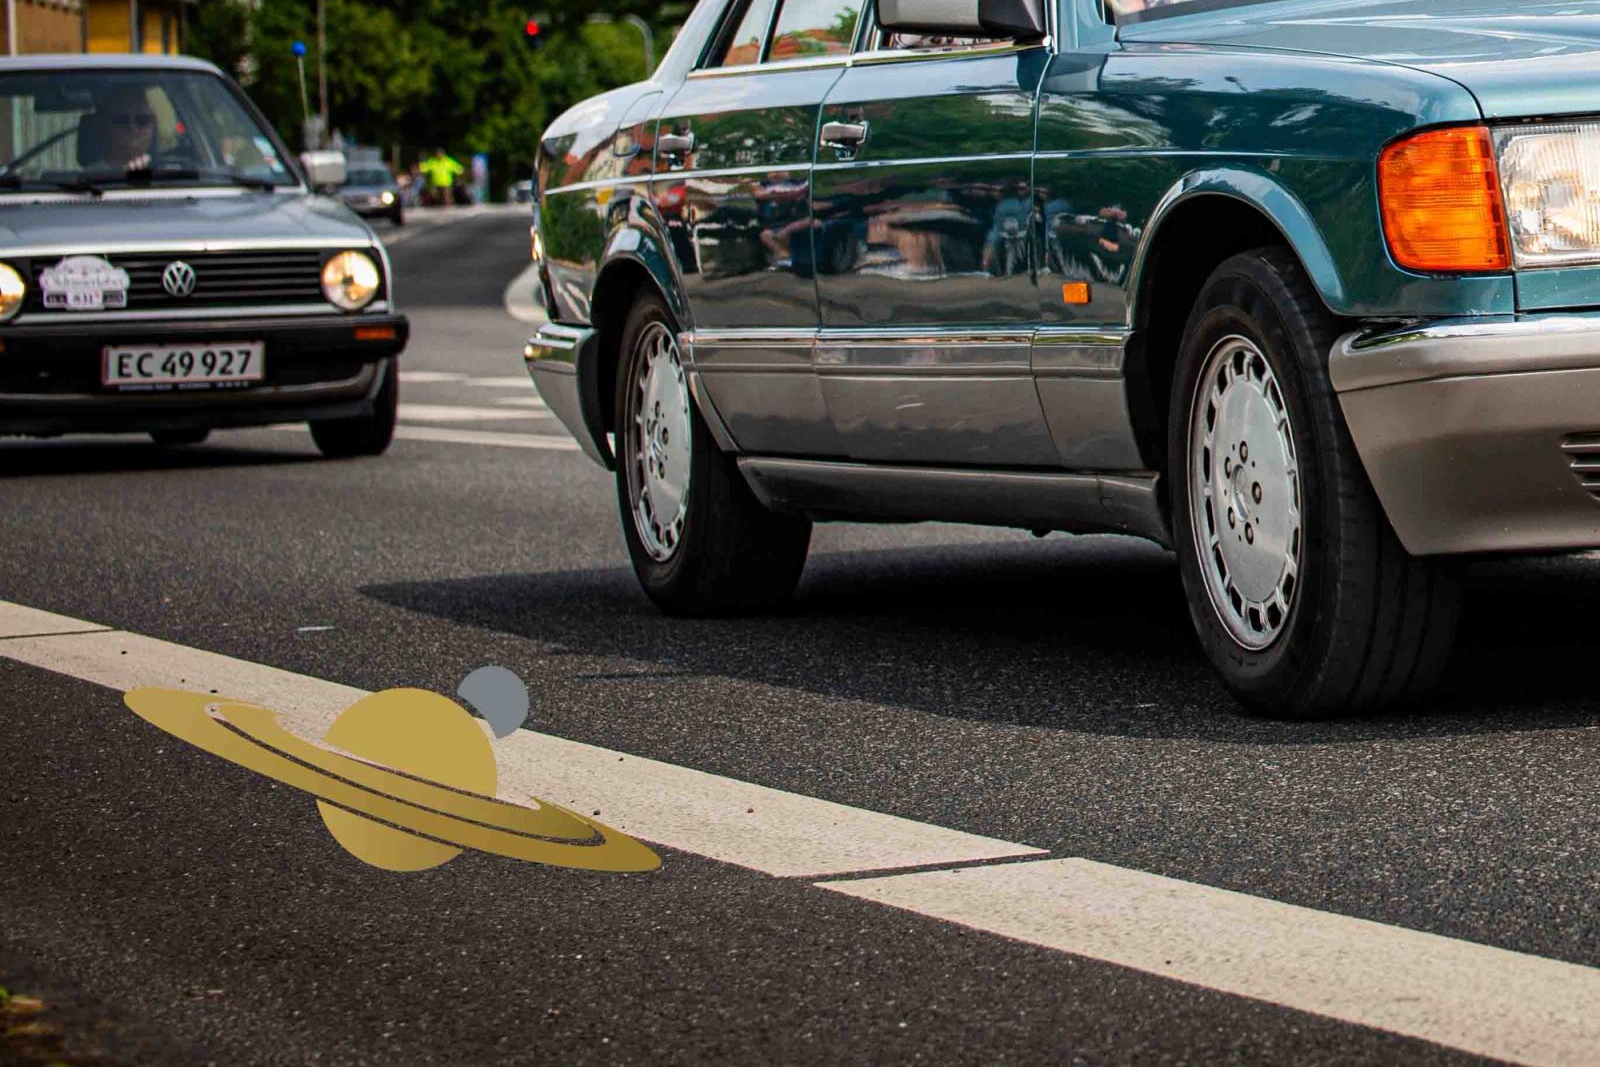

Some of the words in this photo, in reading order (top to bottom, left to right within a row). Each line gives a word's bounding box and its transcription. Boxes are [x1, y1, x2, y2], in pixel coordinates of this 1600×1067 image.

[117, 353, 153, 378] EC
[161, 351, 194, 377] 49
[202, 350, 252, 376] 927
